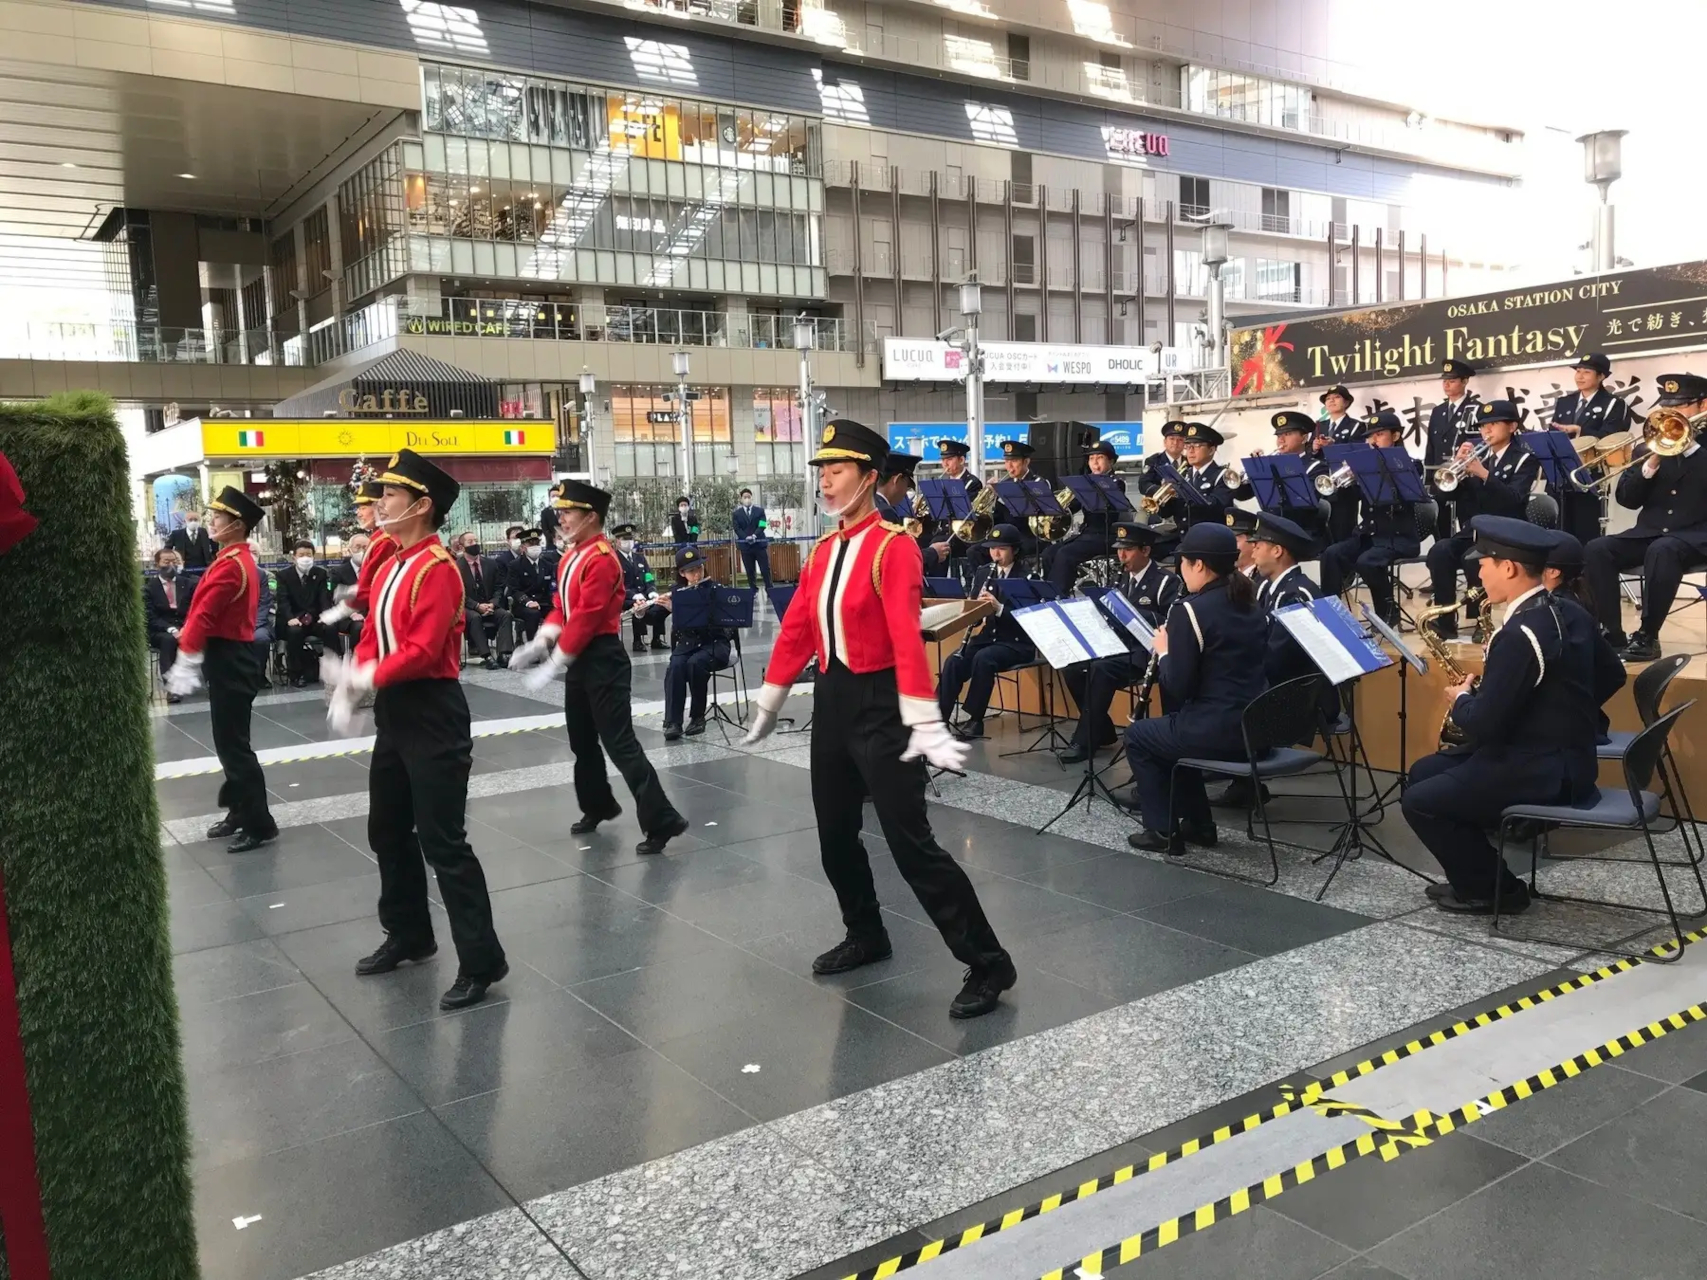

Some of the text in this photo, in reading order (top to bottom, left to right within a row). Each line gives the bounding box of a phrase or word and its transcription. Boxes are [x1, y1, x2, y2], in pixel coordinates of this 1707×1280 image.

[1447, 280, 1623, 318] OSAKA STATION CITY
[428, 320, 472, 333] WIRED
[893, 349, 934, 362] LUCUA
[984, 352, 1005, 360] UCUA
[1307, 324, 1589, 378] Twilight Fantasy
[1063, 361, 1091, 374] WESPO
[1108, 358, 1143, 370] DHOLIC
